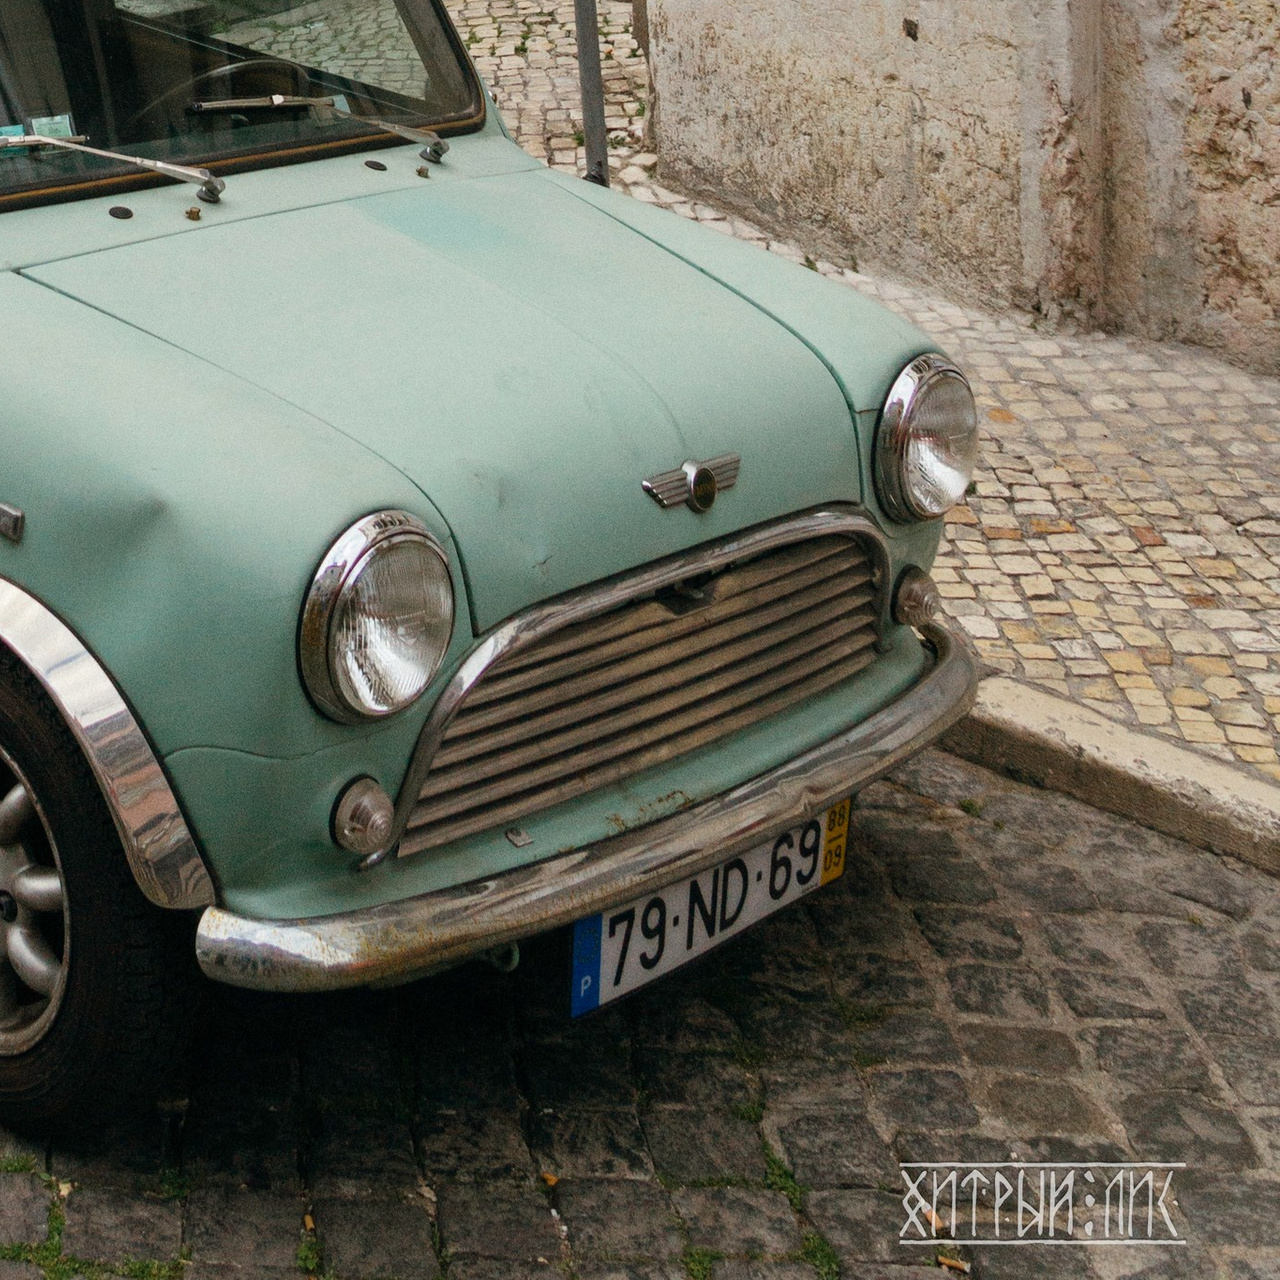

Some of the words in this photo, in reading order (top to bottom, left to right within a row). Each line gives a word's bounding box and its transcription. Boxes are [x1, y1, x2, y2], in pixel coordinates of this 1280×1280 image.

[827, 804, 846, 832] 88
[823, 845, 842, 871] 09
[580, 975, 592, 997] P
